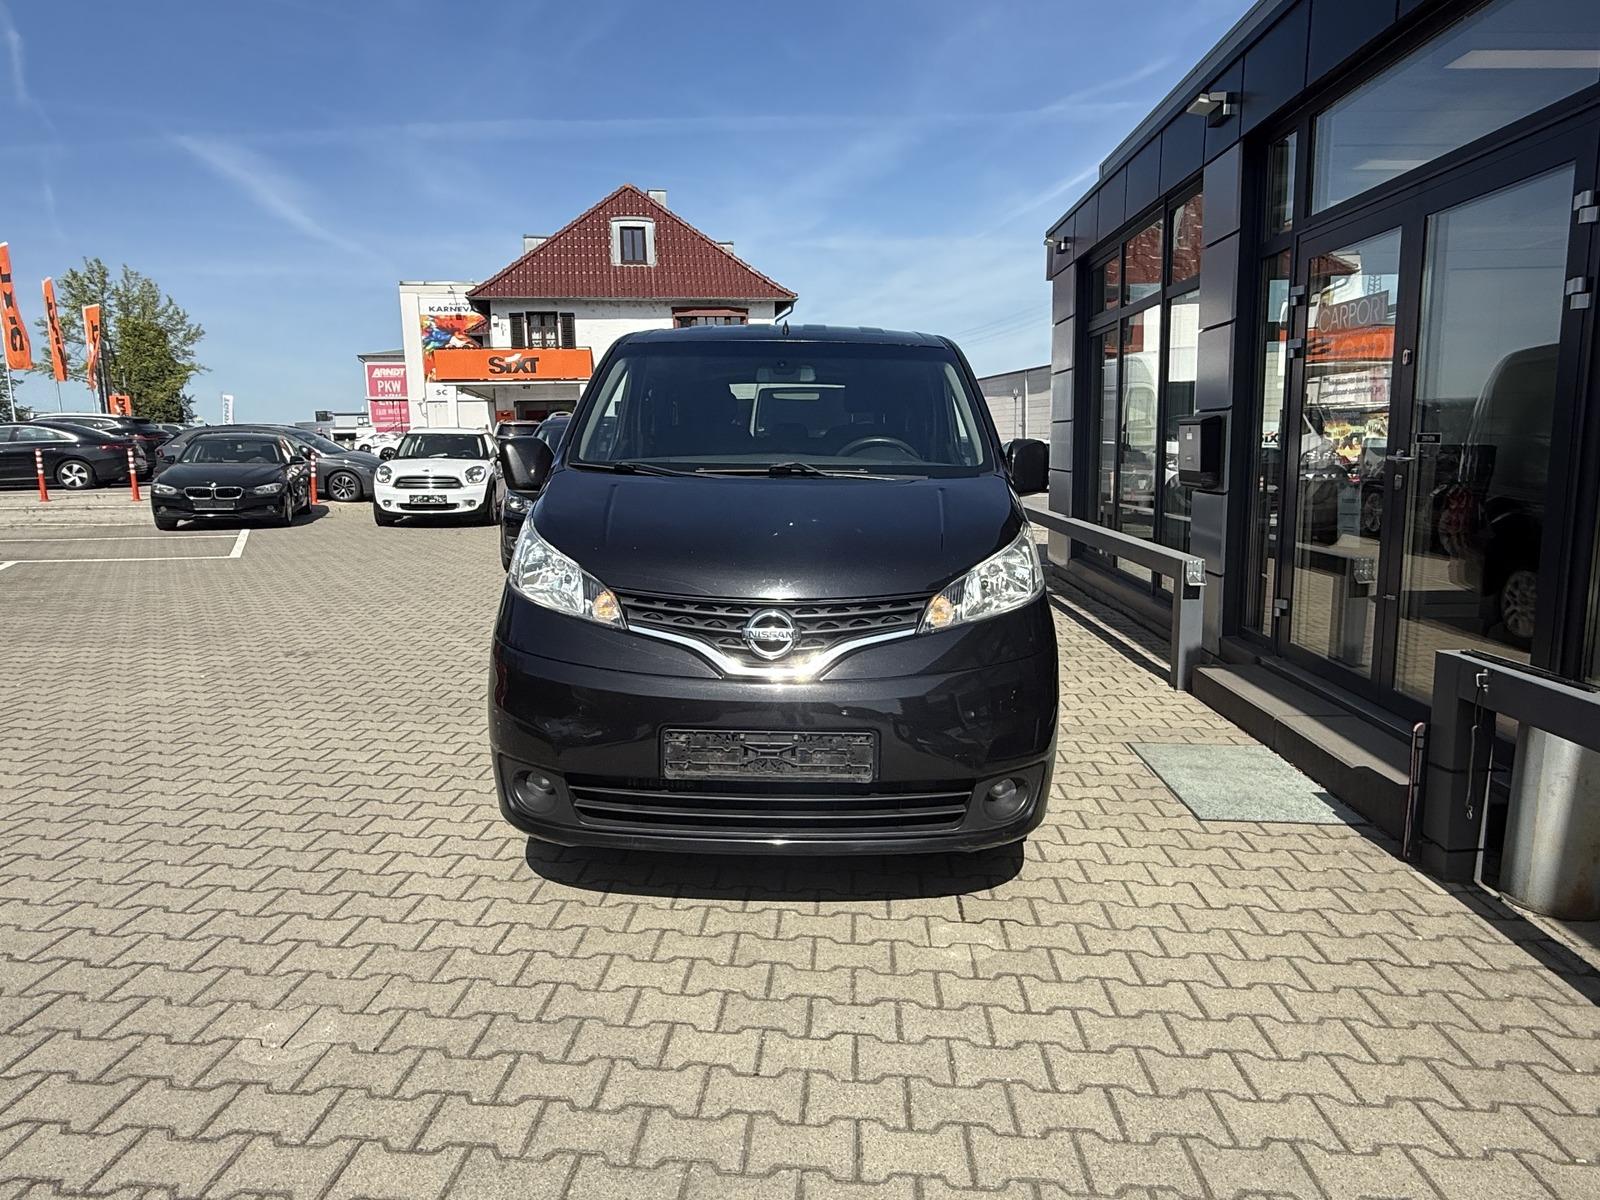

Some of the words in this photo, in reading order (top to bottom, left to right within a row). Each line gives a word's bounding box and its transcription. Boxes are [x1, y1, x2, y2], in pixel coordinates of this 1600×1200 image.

[1319, 294, 1387, 333] CARPORT
[488, 354, 540, 374] SIXT
[371, 367, 406, 378] ARNDT
[377, 380, 401, 393] PKW
[748, 629, 793, 639] NISSAN
